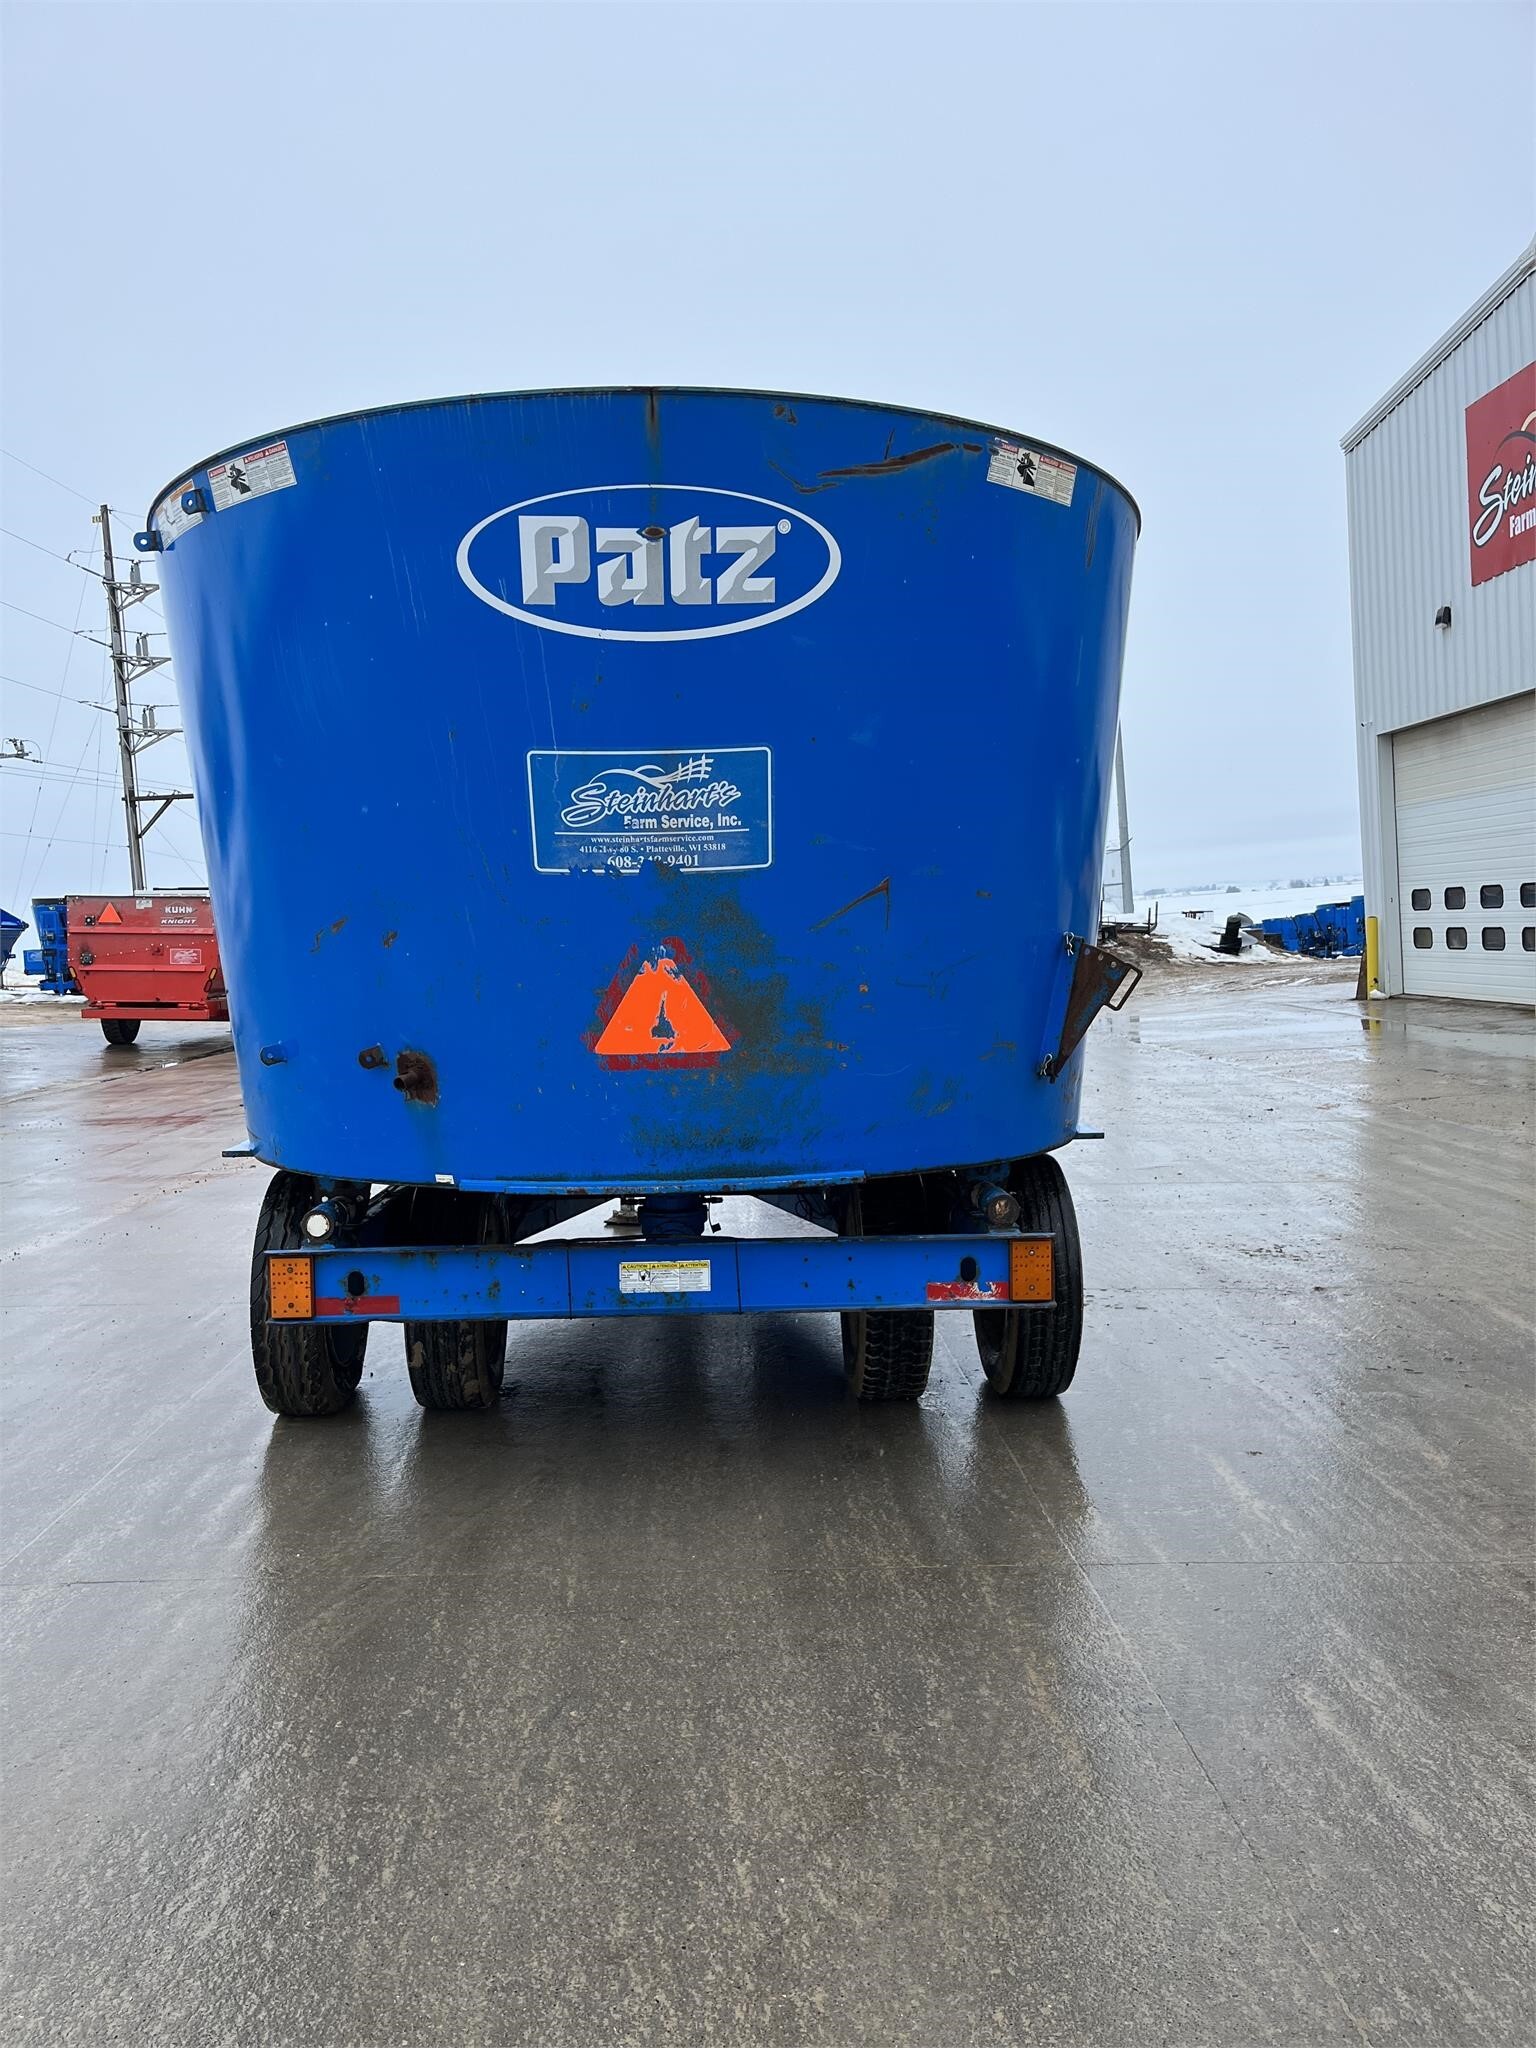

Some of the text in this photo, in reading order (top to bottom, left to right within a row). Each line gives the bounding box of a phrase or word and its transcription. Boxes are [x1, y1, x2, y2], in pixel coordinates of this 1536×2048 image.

[518, 515, 777, 607] Patz
[561, 781, 741, 827] Steinhart's
[624, 813, 742, 830] Farm Service, Inc.
[579, 845, 598, 854] 4116
[646, 844, 688, 854] Platteville,
[689, 843, 702, 852] WI
[703, 842, 727, 852] 53818
